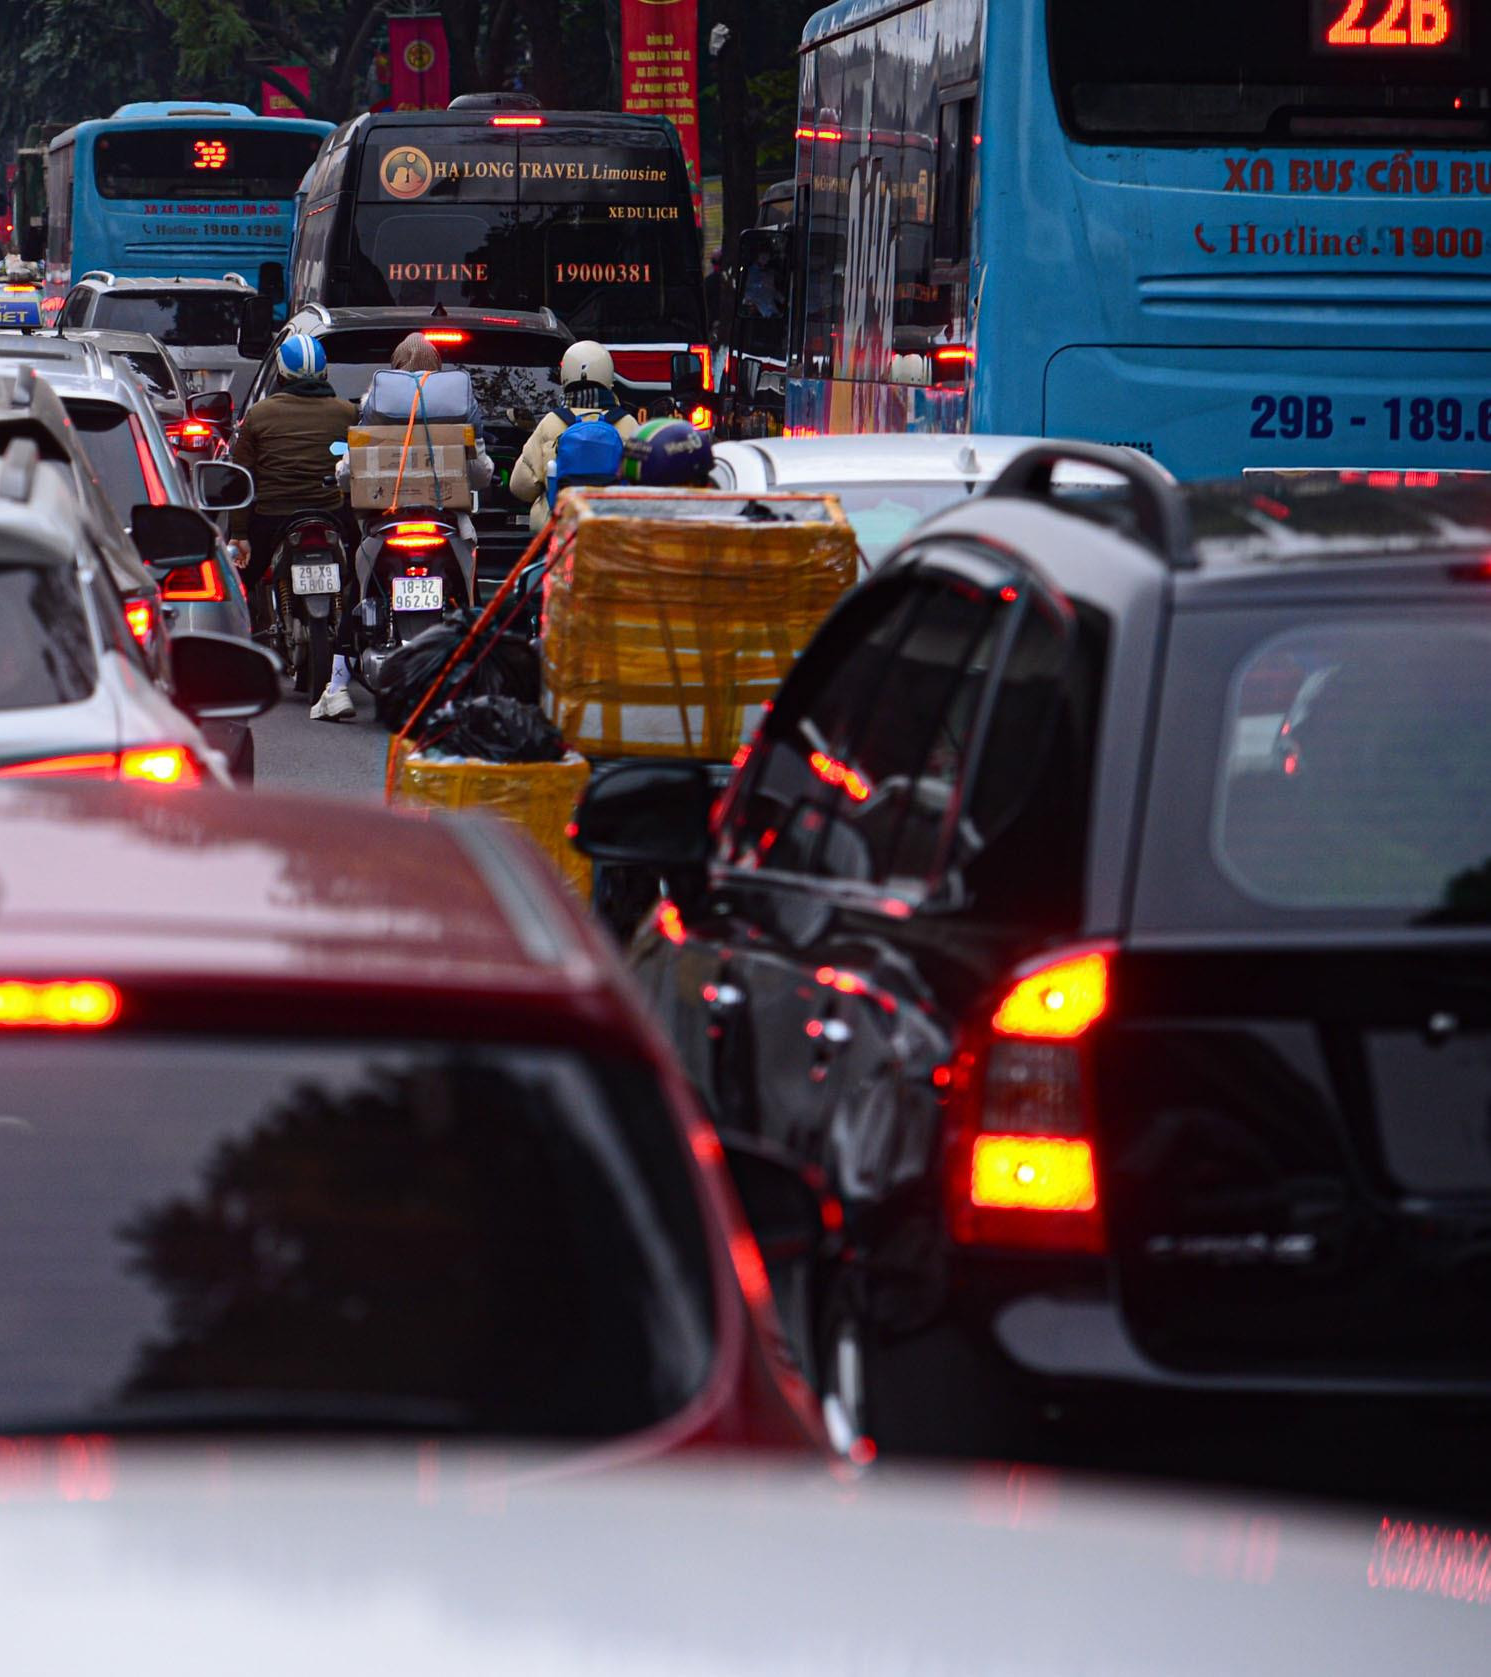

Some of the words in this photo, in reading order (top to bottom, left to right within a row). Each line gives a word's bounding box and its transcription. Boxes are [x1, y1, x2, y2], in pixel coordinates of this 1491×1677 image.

[1327, 0, 1451, 45] 22B
[433, 162, 460, 182] HẠ
[463, 161, 514, 178] LONG
[519, 162, 590, 180] TRAVEL
[592, 165, 667, 182] Limousine
[1288, 159, 1355, 193] BUS
[608, 206, 627, 219] XE
[627, 206, 647, 219] DU
[388, 263, 488, 281] HOTLINE
[555, 263, 651, 282] 19000381
[1249, 395, 1334, 440] 29B
[396, 595, 440, 608] 962.49
